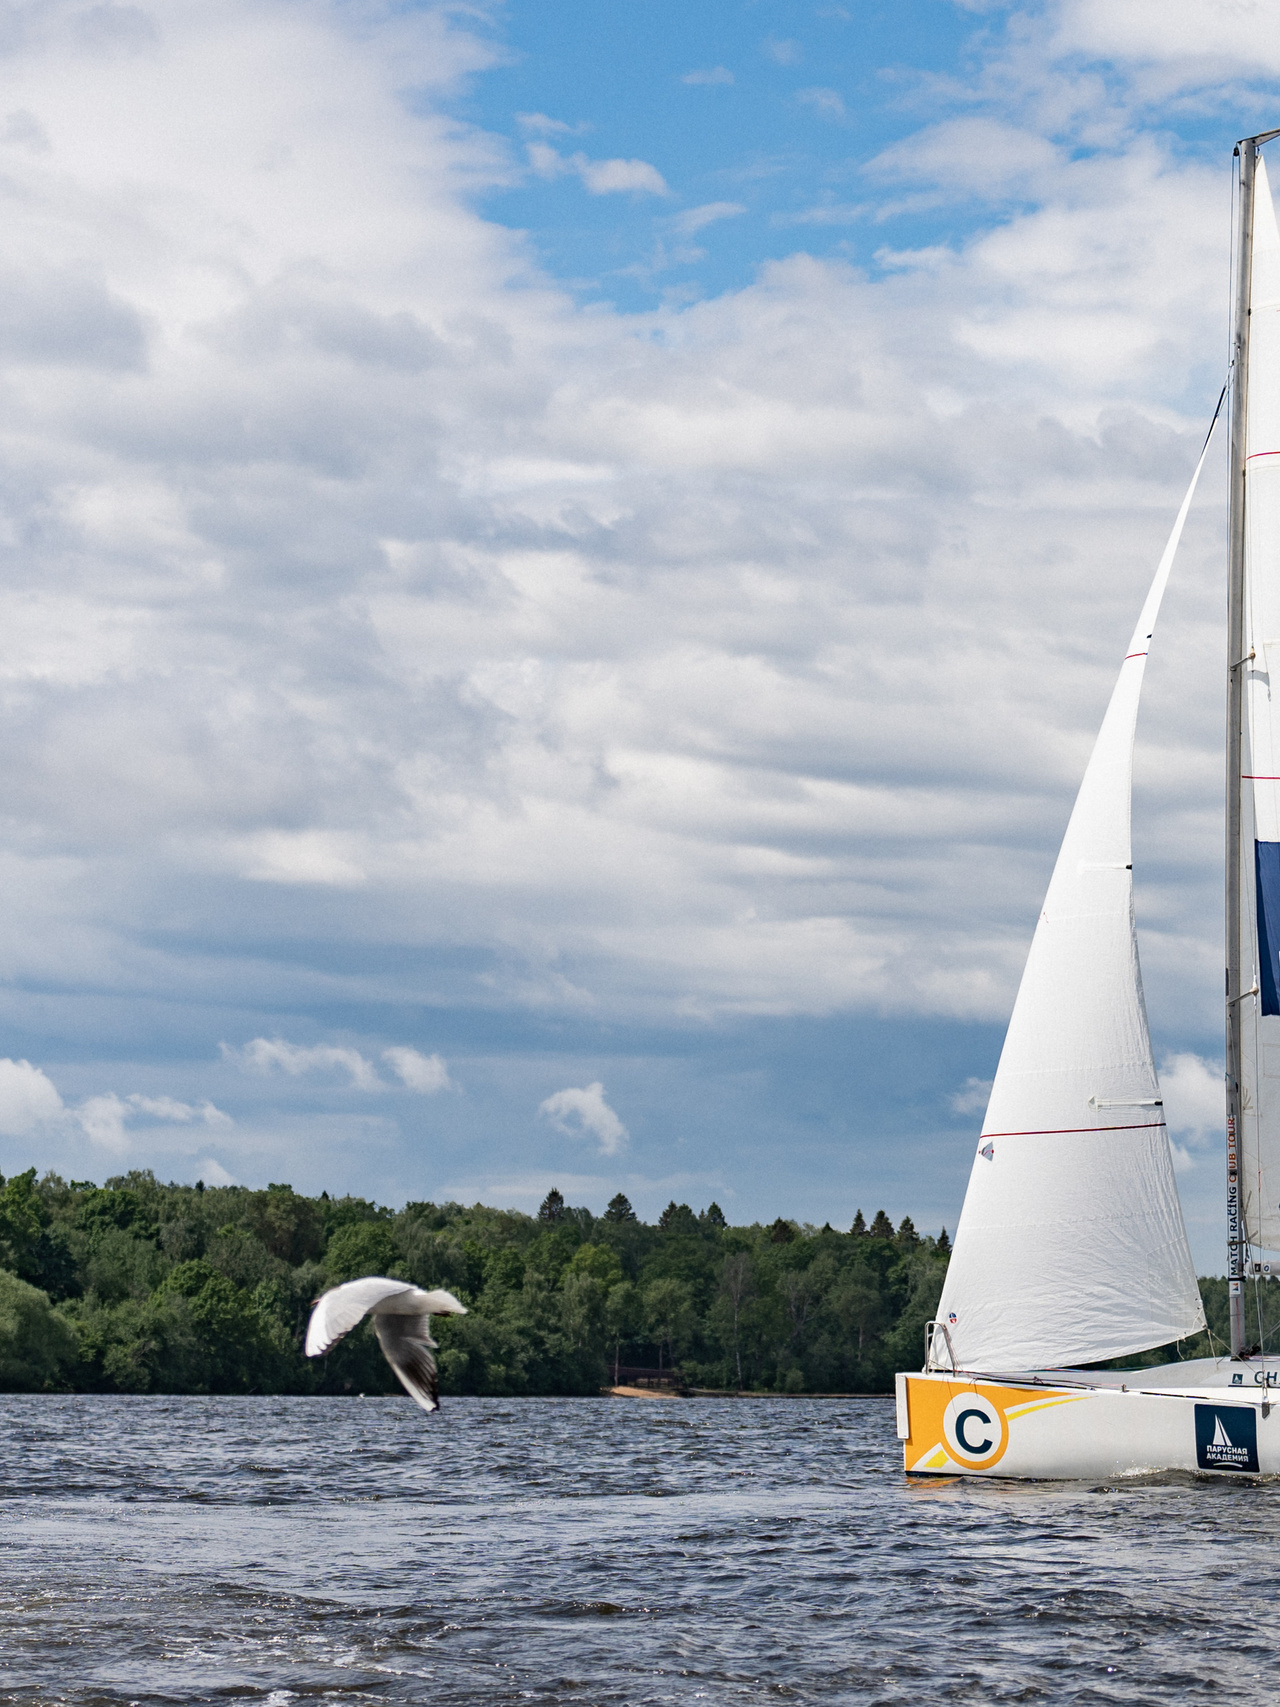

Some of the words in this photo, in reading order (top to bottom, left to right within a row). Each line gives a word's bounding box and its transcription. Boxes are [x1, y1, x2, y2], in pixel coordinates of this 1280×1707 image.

[1228, 1152, 1237, 1183] CUB
[1229, 1186, 1237, 1232] RACING
[1230, 1236, 1238, 1275] MATCH
[955, 1408, 993, 1454] C
[1206, 1445, 1248, 1455] ПАРУСНАЯ
[1206, 1452, 1249, 1462] АКАДЕМИЯ
